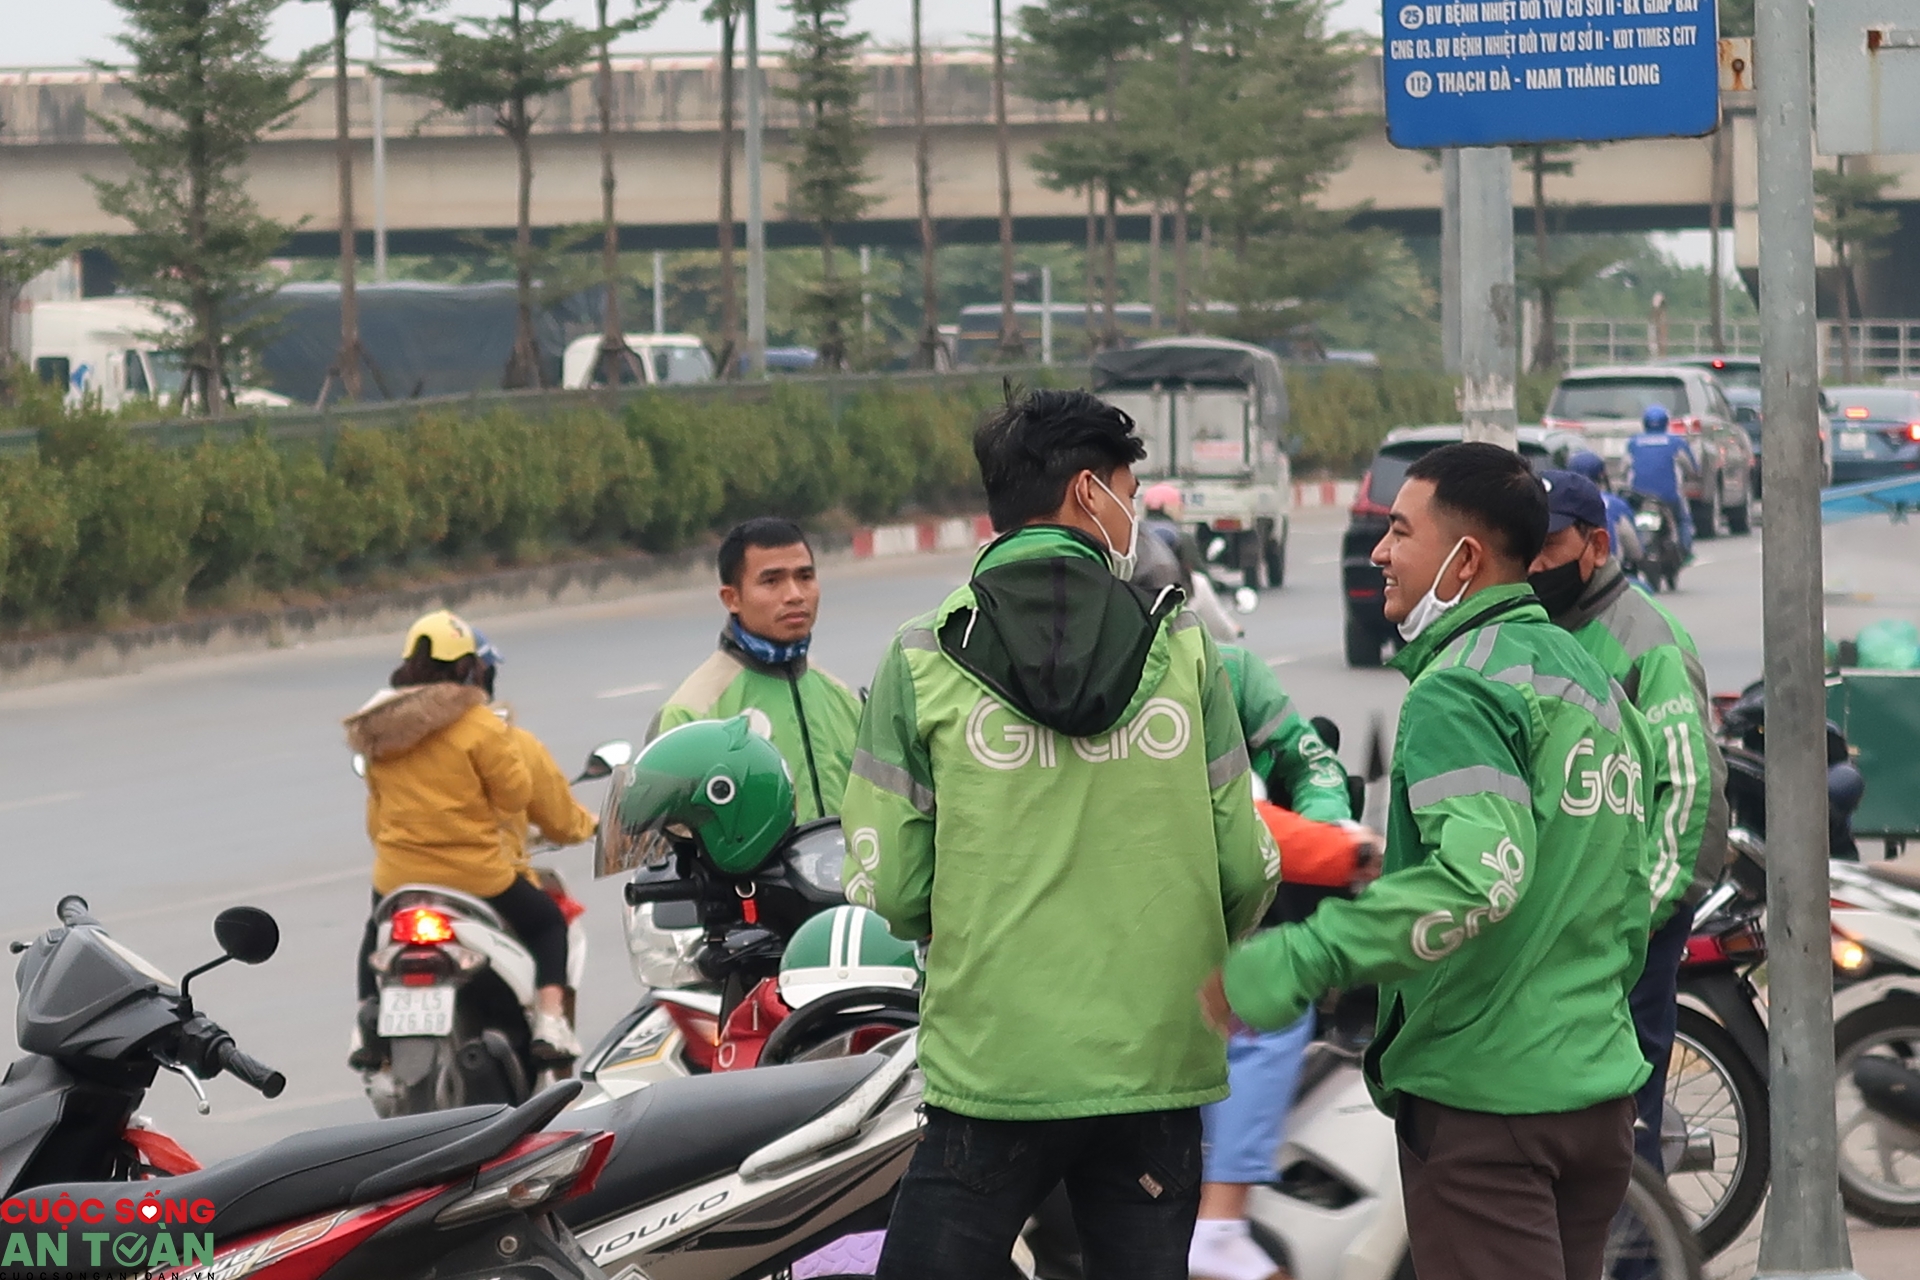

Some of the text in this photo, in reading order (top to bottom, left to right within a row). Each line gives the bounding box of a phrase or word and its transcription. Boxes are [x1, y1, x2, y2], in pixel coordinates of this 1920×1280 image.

[1404, 10, 1420, 24] 25
[1426, 5, 1442, 25] BV
[1391, 39, 1414, 60] CNG
[1436, 37, 1450, 58] BV
[1540, 32, 1557, 53] TW
[1636, 27, 1670, 48] TIMES
[1673, 25, 1697, 46] CITY
[1410, 77, 1428, 92] 112
[1436, 70, 1487, 97] THẠCH
[1490, 65, 1511, 91] ĐÀ
[1526, 68, 1562, 90] NAM
[1566, 62, 1616, 89] THĂNG
[1619, 63, 1660, 86] LONG
[1646, 693, 1694, 724] Grab
[1411, 837, 1525, 961] Grab
